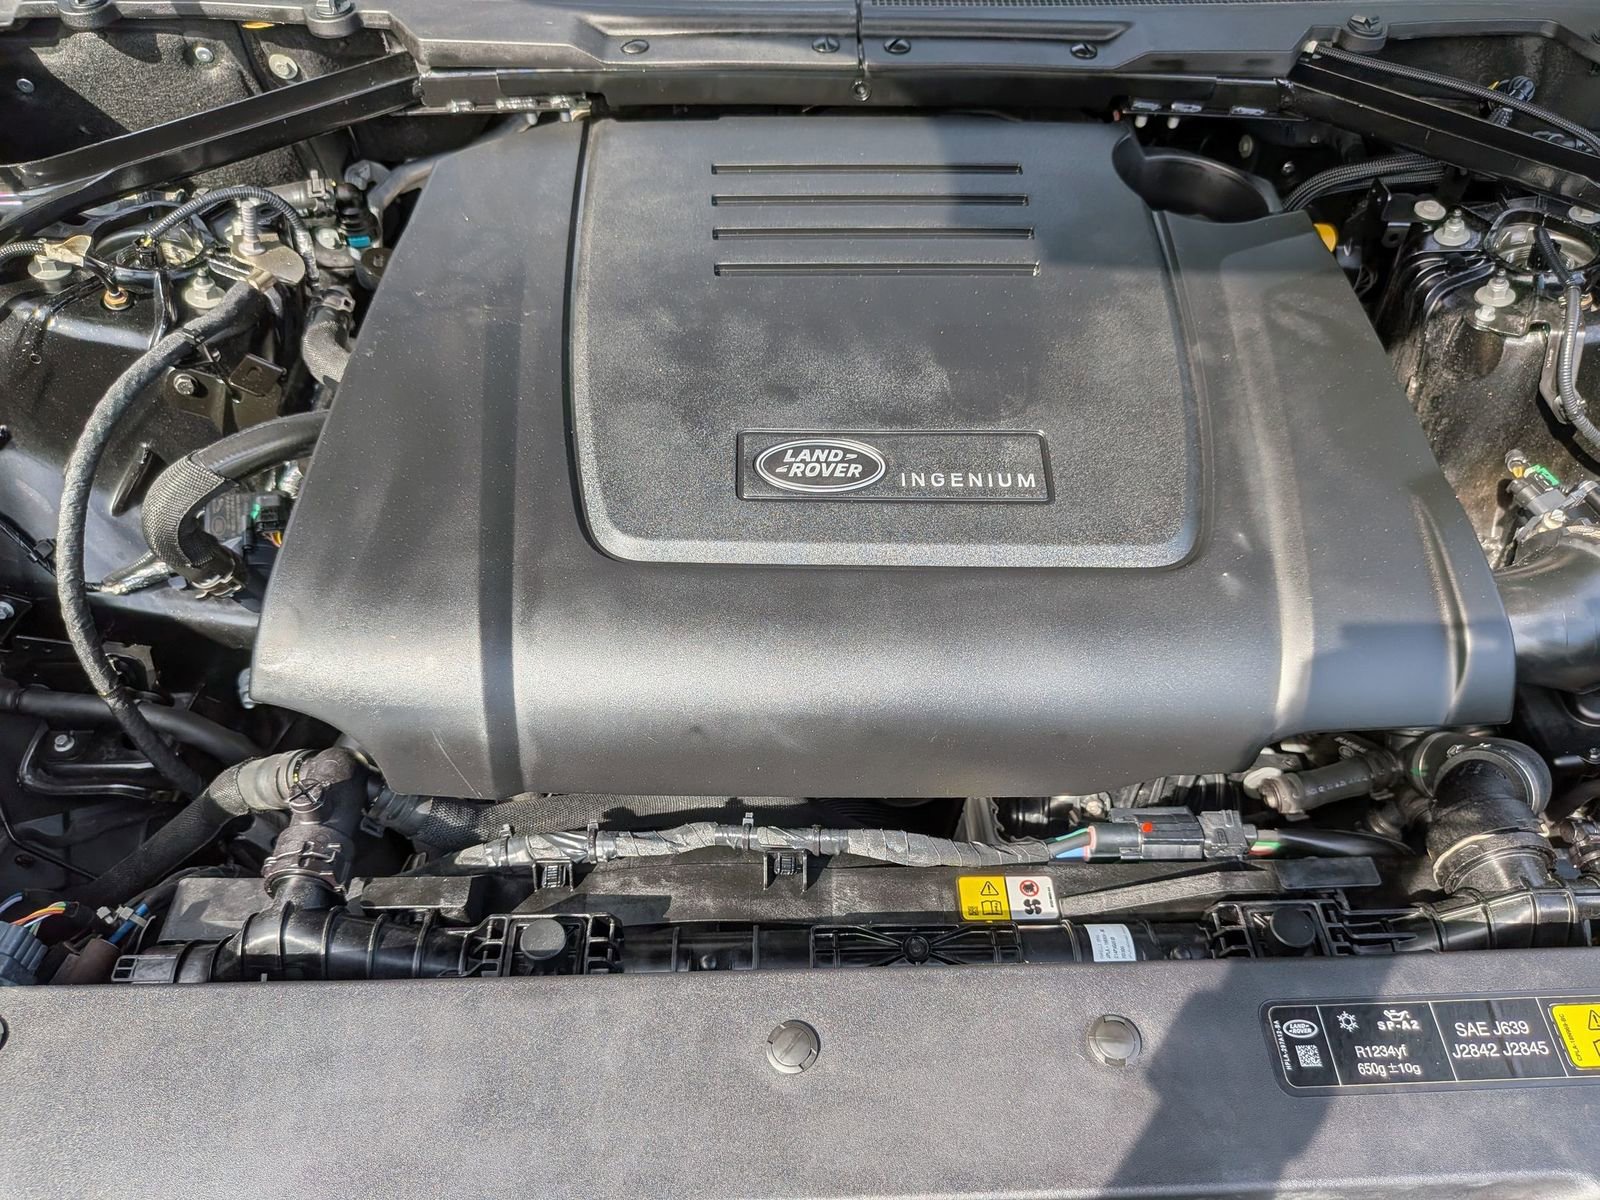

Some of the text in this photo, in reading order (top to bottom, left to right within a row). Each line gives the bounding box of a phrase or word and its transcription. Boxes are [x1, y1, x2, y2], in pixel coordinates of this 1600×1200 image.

[782, 448, 845, 463] LAND
[788, 463, 863, 478] ROVER
[900, 472, 1037, 488] INGENIUM
[1377, 1020, 1420, 1031] SP-A2
[1454, 1020, 1529, 1037] SAE J639
[1354, 1044, 1407, 1060] R1234yf
[1452, 1040, 1549, 1059] J2842 J2845
[1357, 1062, 1421, 1077] 650g ±10g
